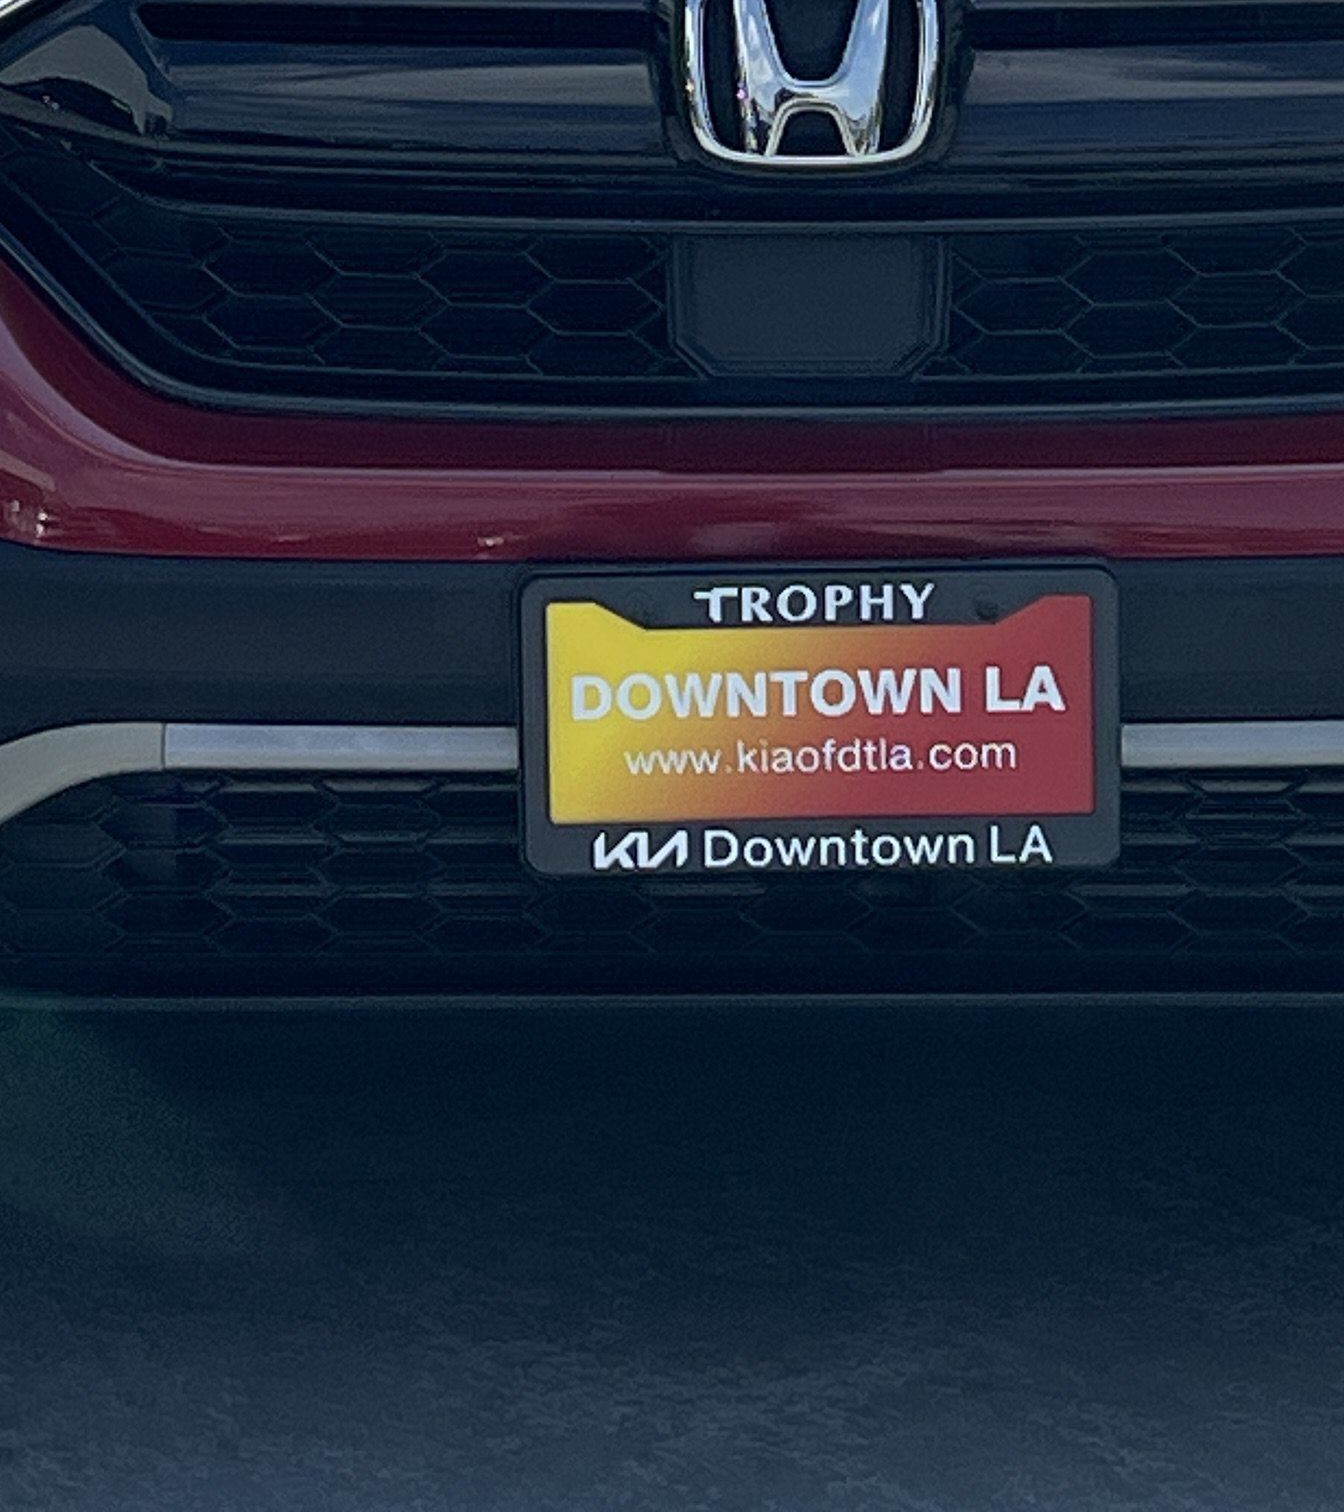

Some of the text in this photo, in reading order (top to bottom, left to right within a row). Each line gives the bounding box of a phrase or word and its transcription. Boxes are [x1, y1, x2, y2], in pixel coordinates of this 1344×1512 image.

[694, 583, 935, 624] TROPHY
[571, 665, 1066, 721] DOWNTOWN LA
[624, 738, 1017, 775] www.kiaofdtla.com
[592, 824, 1053, 870] KIA Downtown LA
